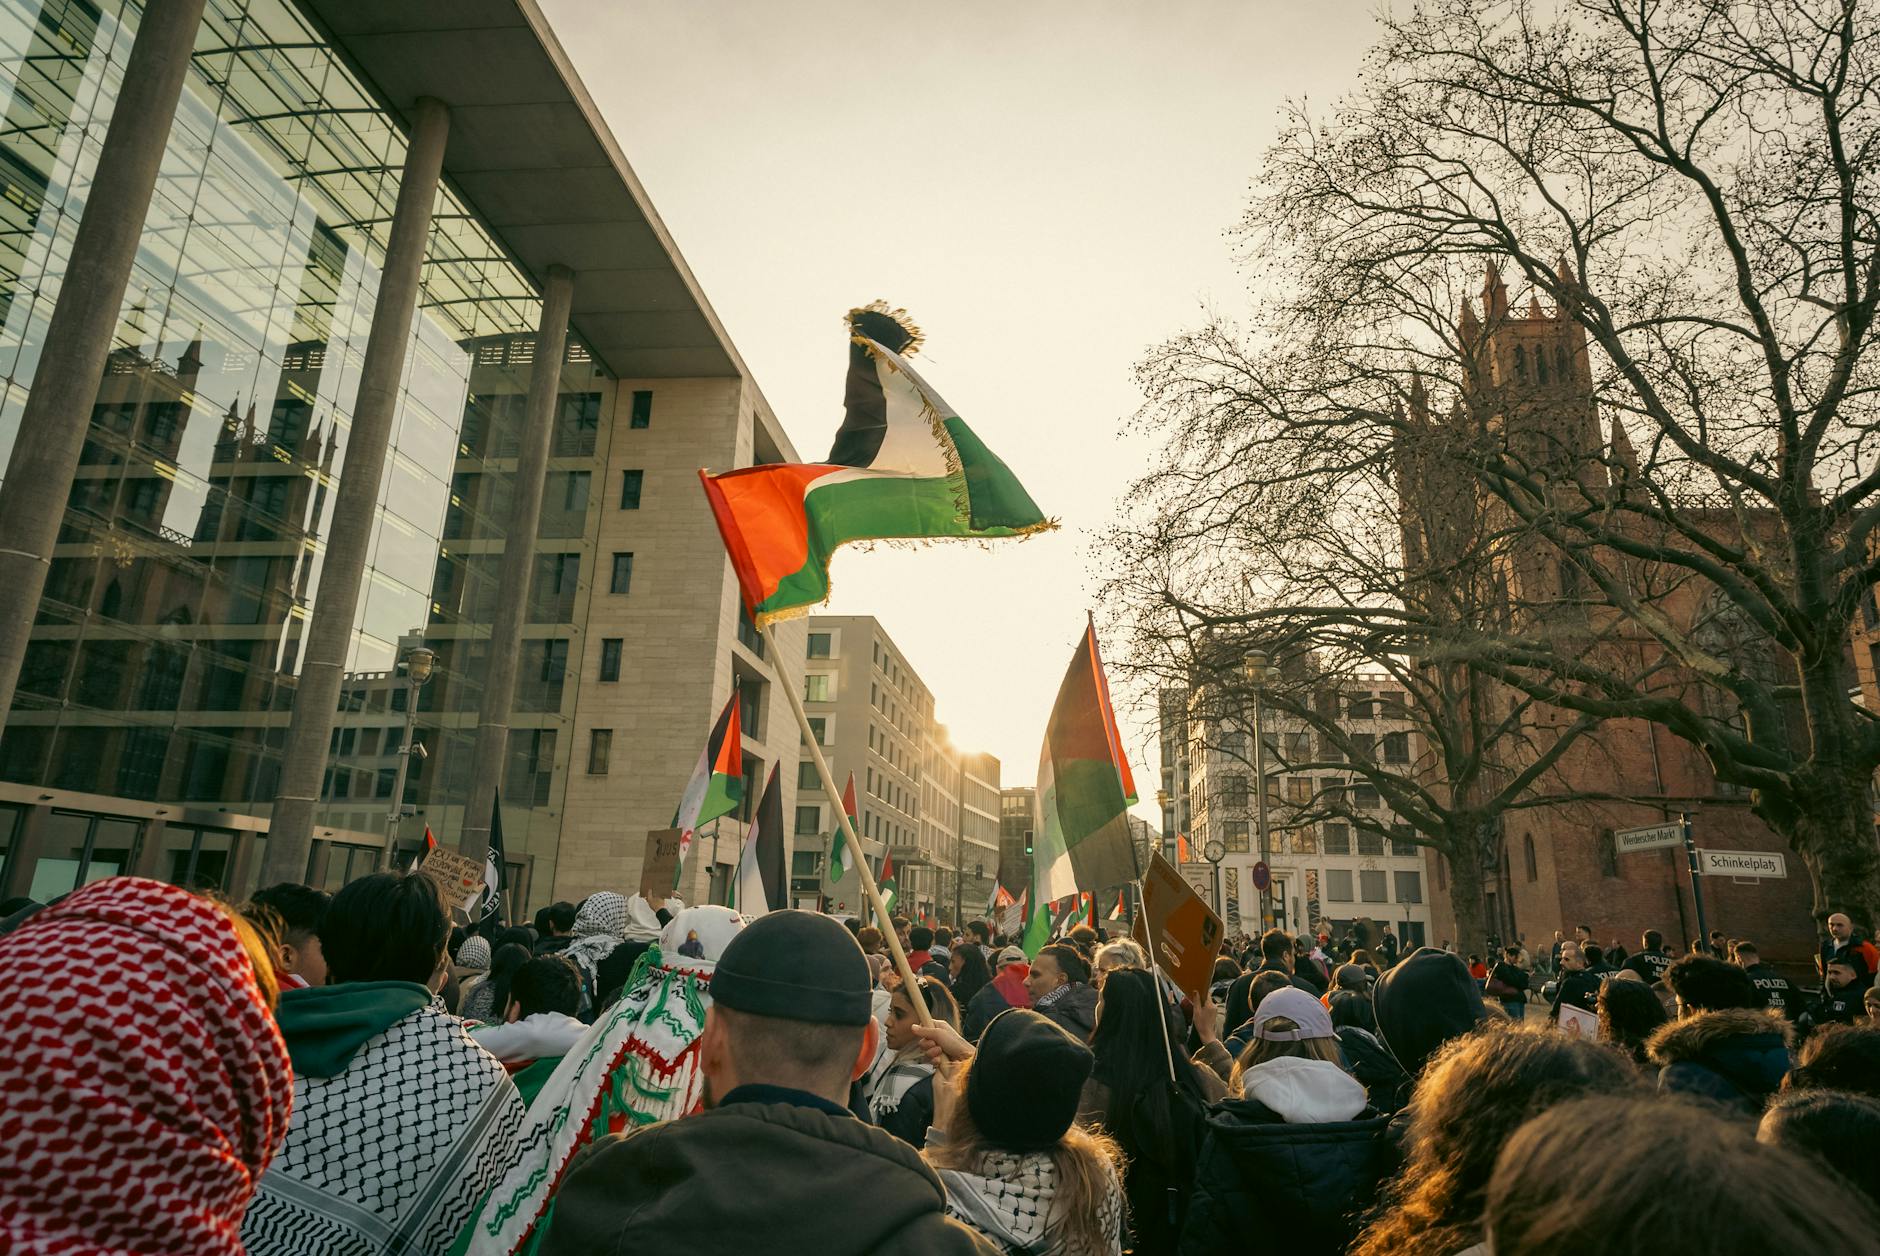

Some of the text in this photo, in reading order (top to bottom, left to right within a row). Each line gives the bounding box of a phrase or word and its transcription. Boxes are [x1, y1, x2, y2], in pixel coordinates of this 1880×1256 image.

[1622, 829, 1676, 847] Werderscher Markt
[1711, 855, 1776, 873] Schinkelplatz
[1753, 978, 1789, 990] POLIZEI
[1771, 991, 1780, 999] BE
